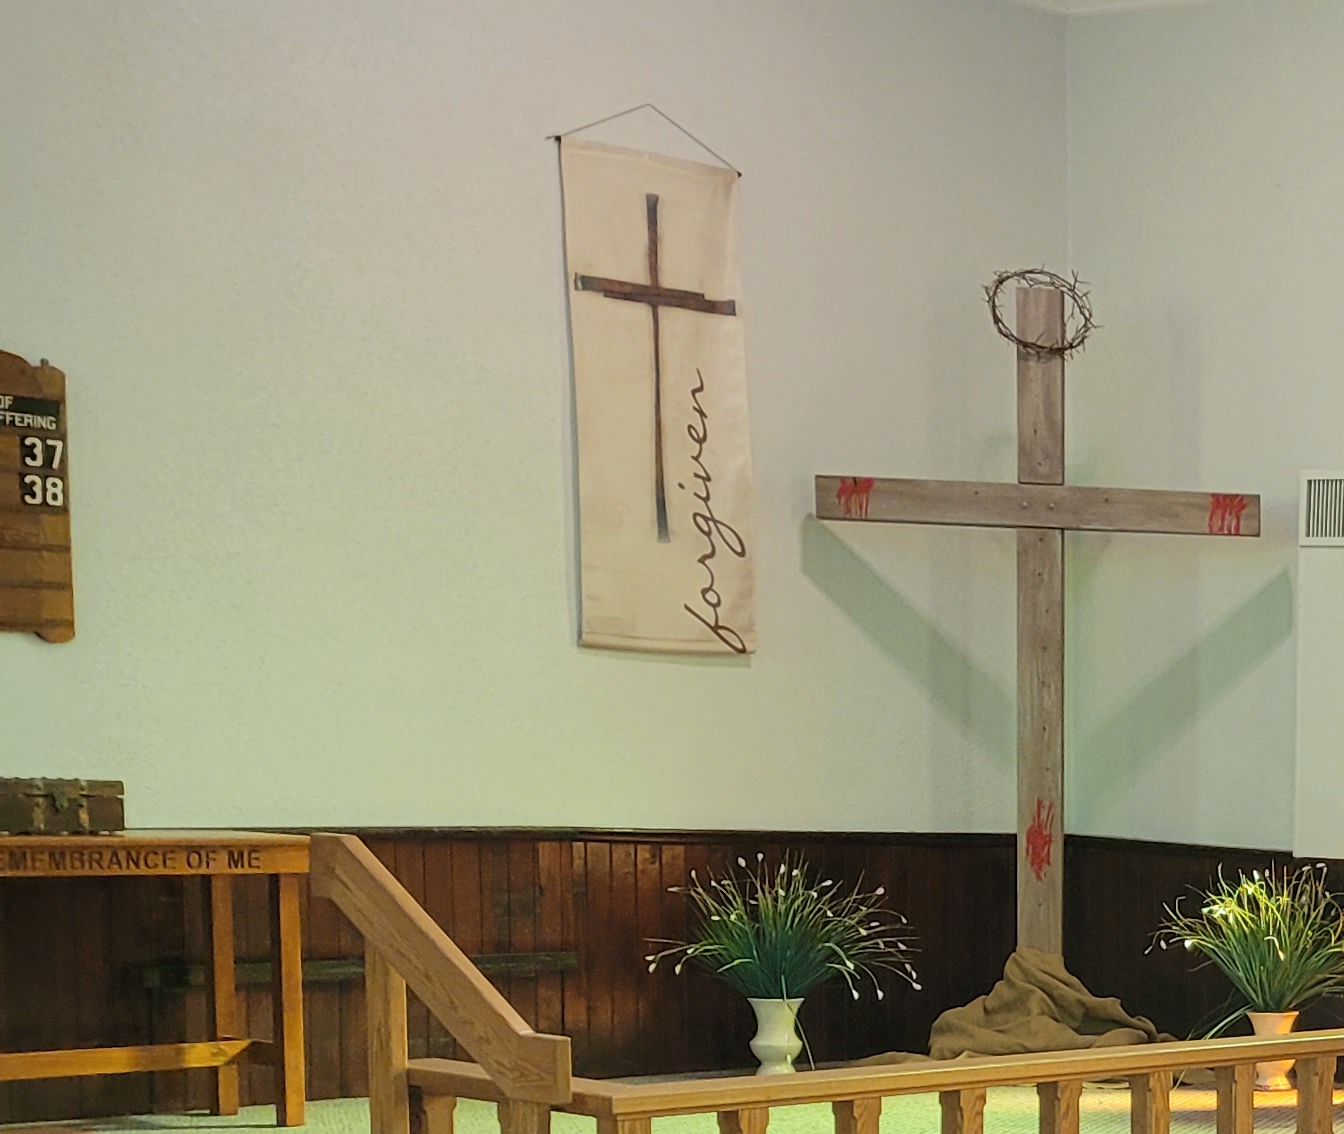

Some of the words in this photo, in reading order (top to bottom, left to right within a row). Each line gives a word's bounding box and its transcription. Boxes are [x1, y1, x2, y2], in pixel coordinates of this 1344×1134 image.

[24, 437, 64, 470] 37
[24, 475, 64, 507] 38
[678, 366, 748, 654] forgiven
[186, 850, 218, 870] OF
[227, 849, 262, 869] ME
